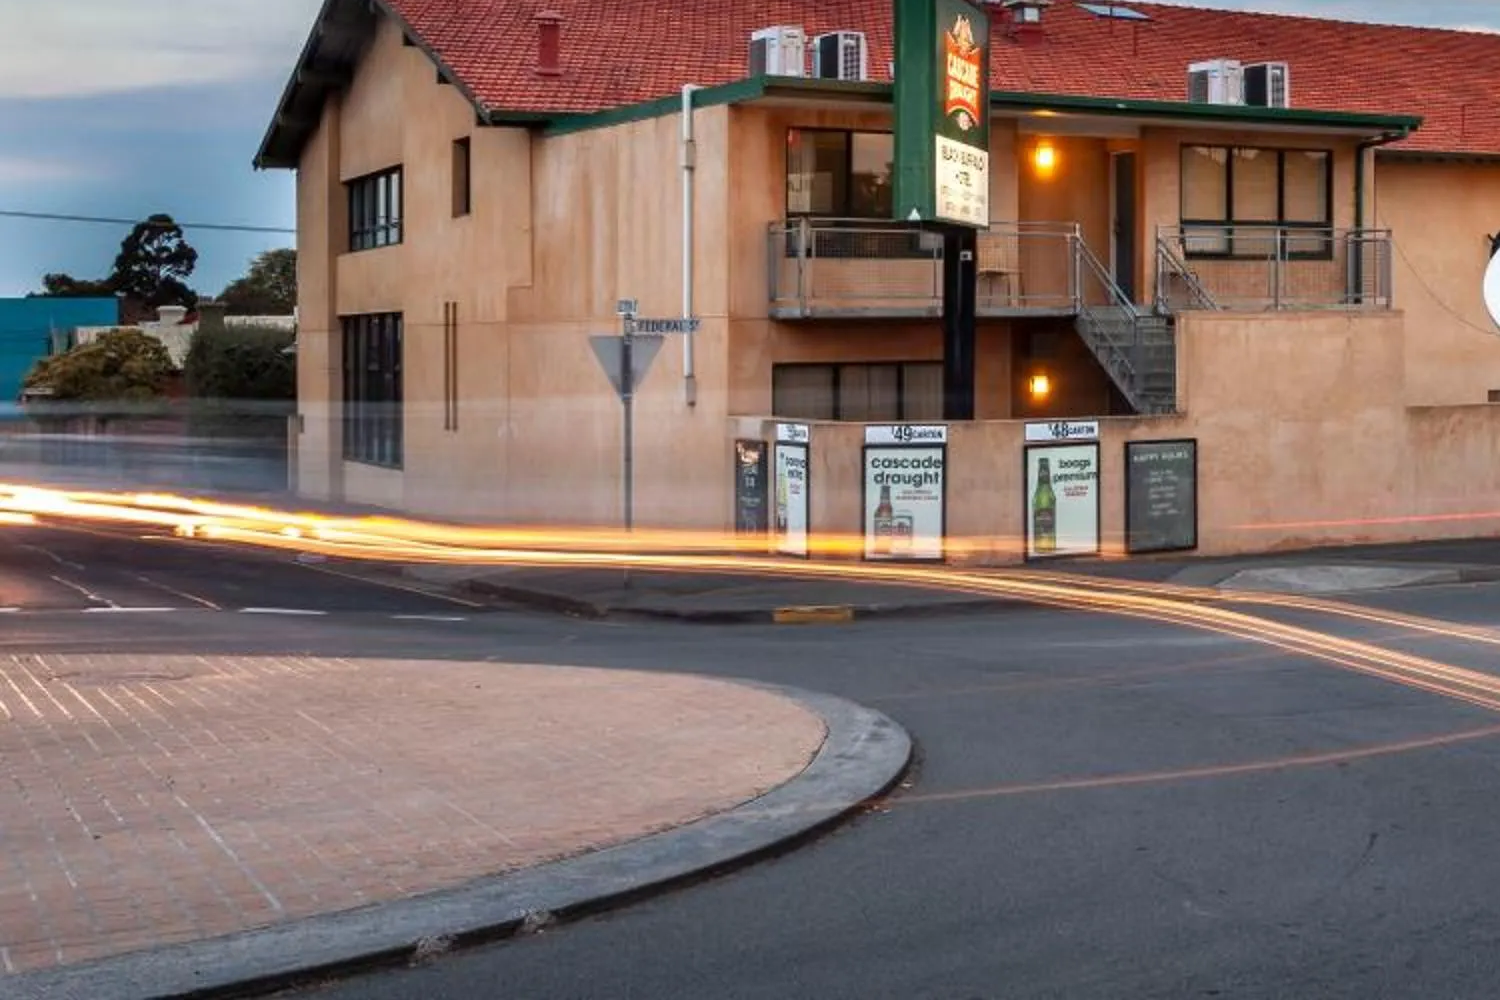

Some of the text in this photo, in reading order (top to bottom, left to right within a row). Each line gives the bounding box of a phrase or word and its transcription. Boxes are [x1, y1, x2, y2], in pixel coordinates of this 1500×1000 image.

[637, 319, 684, 333] FEDERAL
[871, 456, 942, 469] cascade
[873, 471, 940, 488] draught
